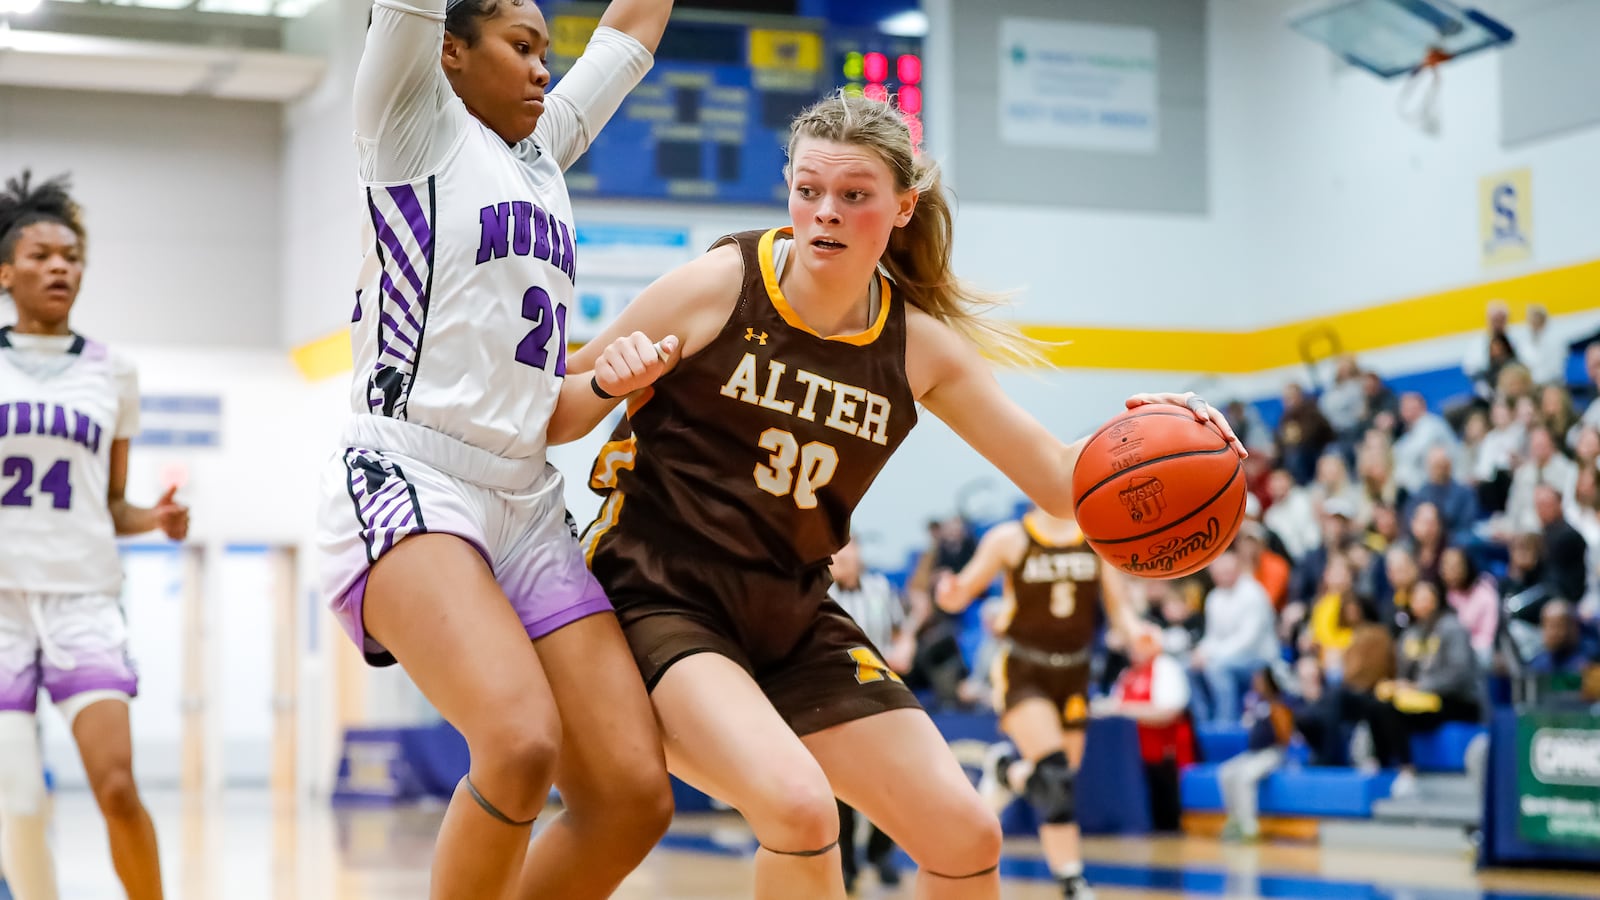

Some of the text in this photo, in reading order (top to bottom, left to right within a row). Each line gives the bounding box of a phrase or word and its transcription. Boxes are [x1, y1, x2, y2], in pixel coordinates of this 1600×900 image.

[475, 201, 577, 287] NUBIA
[514, 286, 567, 378] 21
[720, 352, 891, 446] ALTER
[1, 456, 72, 510] 24
[753, 427, 840, 510] 30
[1121, 516, 1220, 572] Rawlings
